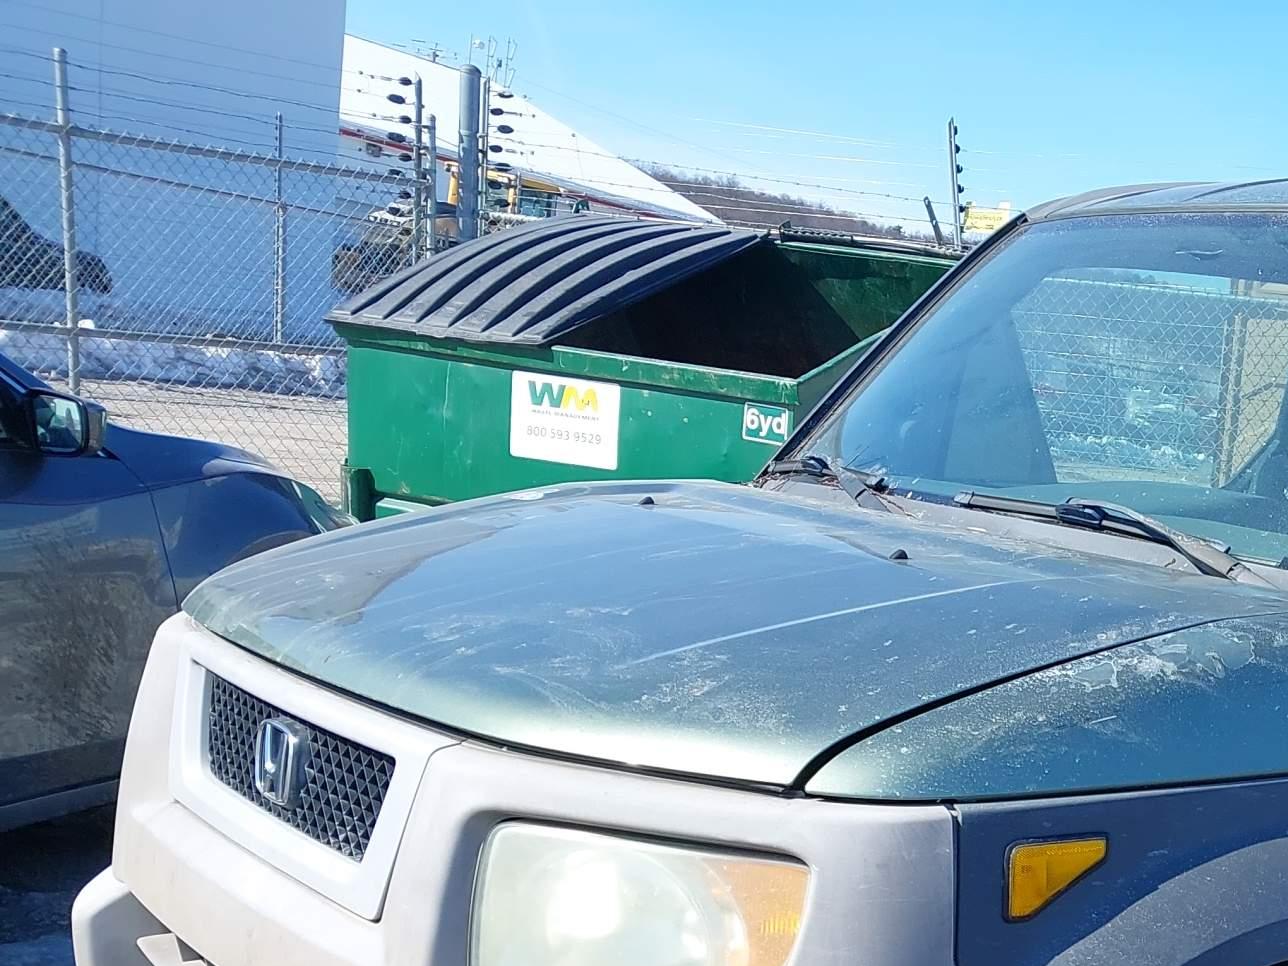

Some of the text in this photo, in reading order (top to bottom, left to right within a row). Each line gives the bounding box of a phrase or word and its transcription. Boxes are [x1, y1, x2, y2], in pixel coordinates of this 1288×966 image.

[528, 380, 598, 412] WM
[527, 425, 602, 445] 800 593 9529
[746, 407, 786, 437] 6yd
